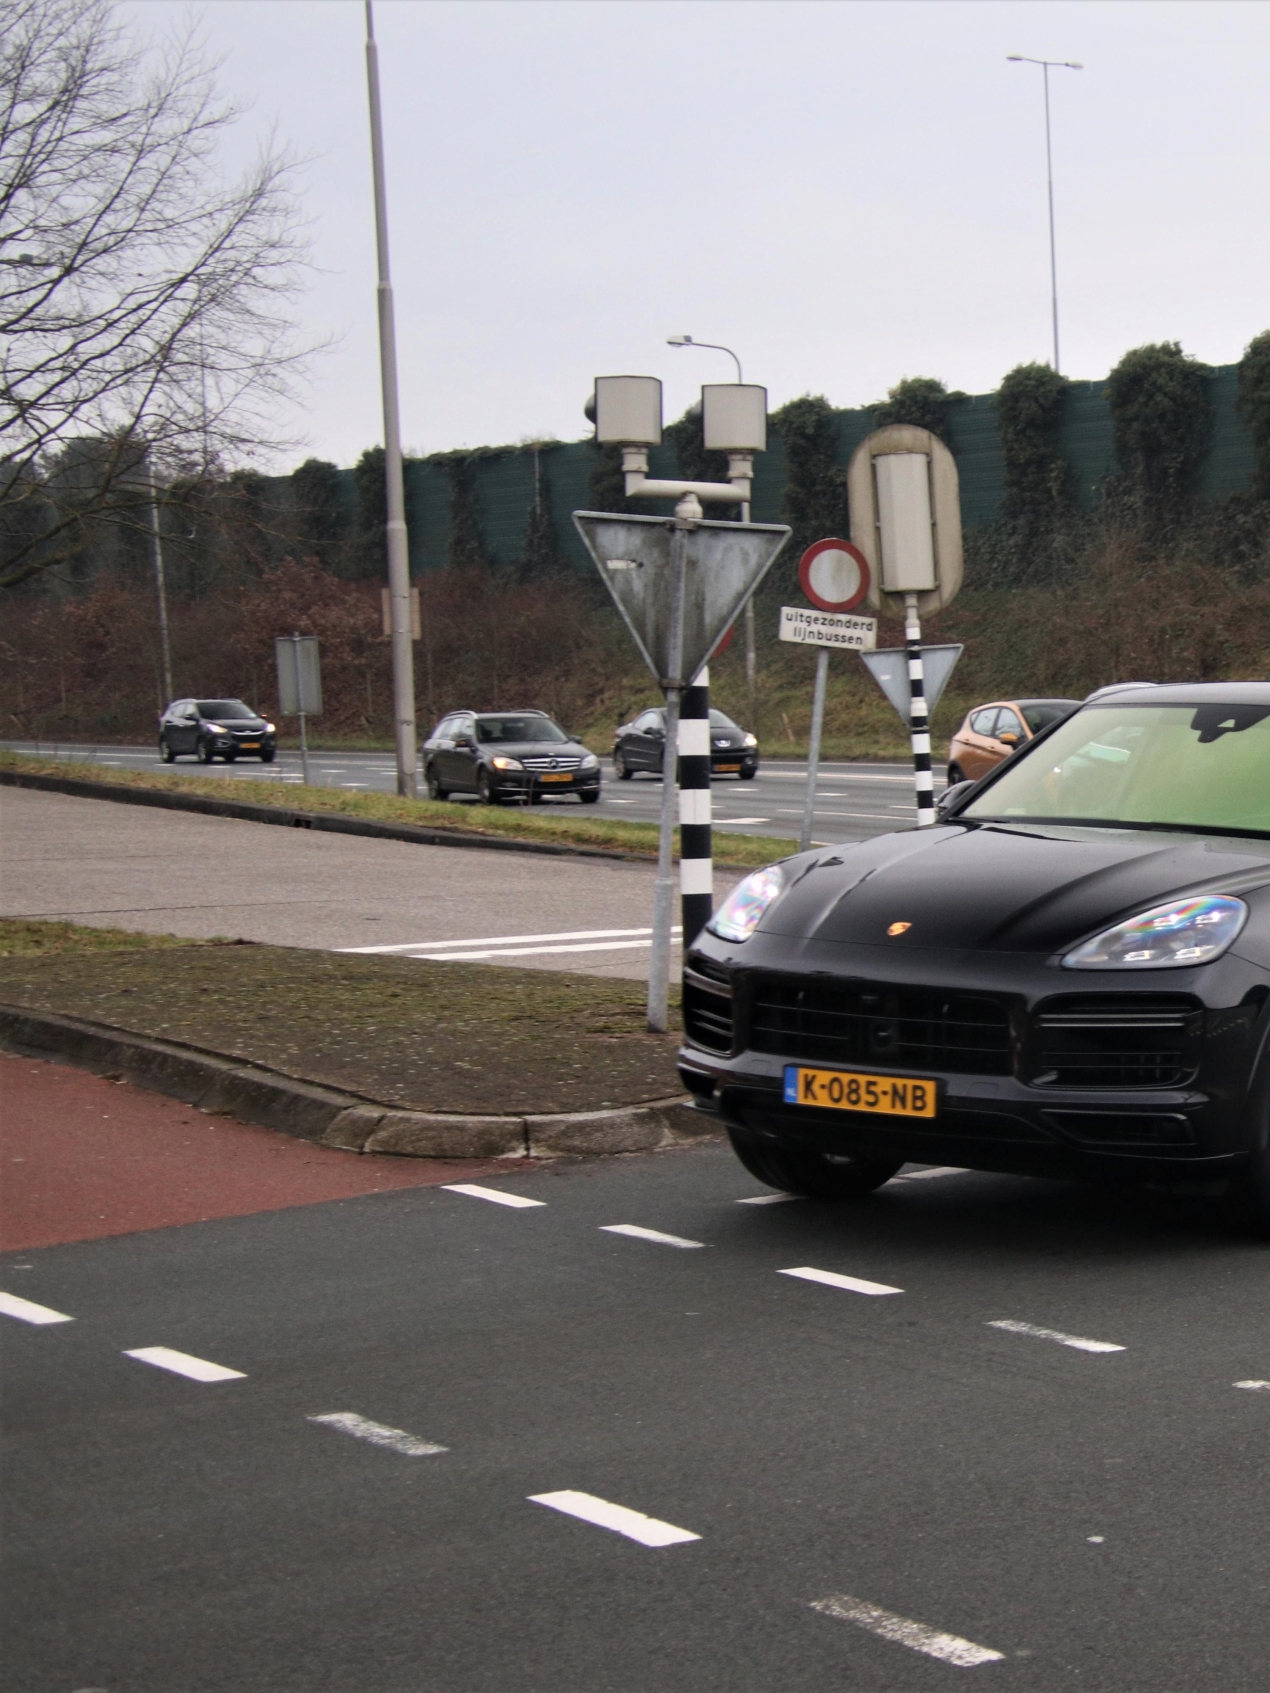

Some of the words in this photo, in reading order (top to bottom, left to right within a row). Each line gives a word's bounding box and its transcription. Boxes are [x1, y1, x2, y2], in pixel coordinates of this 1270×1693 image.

[785, 612, 873, 631] uitgezonderd
[793, 627, 863, 645] lijnbussen
[803, 1073, 927, 1112] K-085-NB
